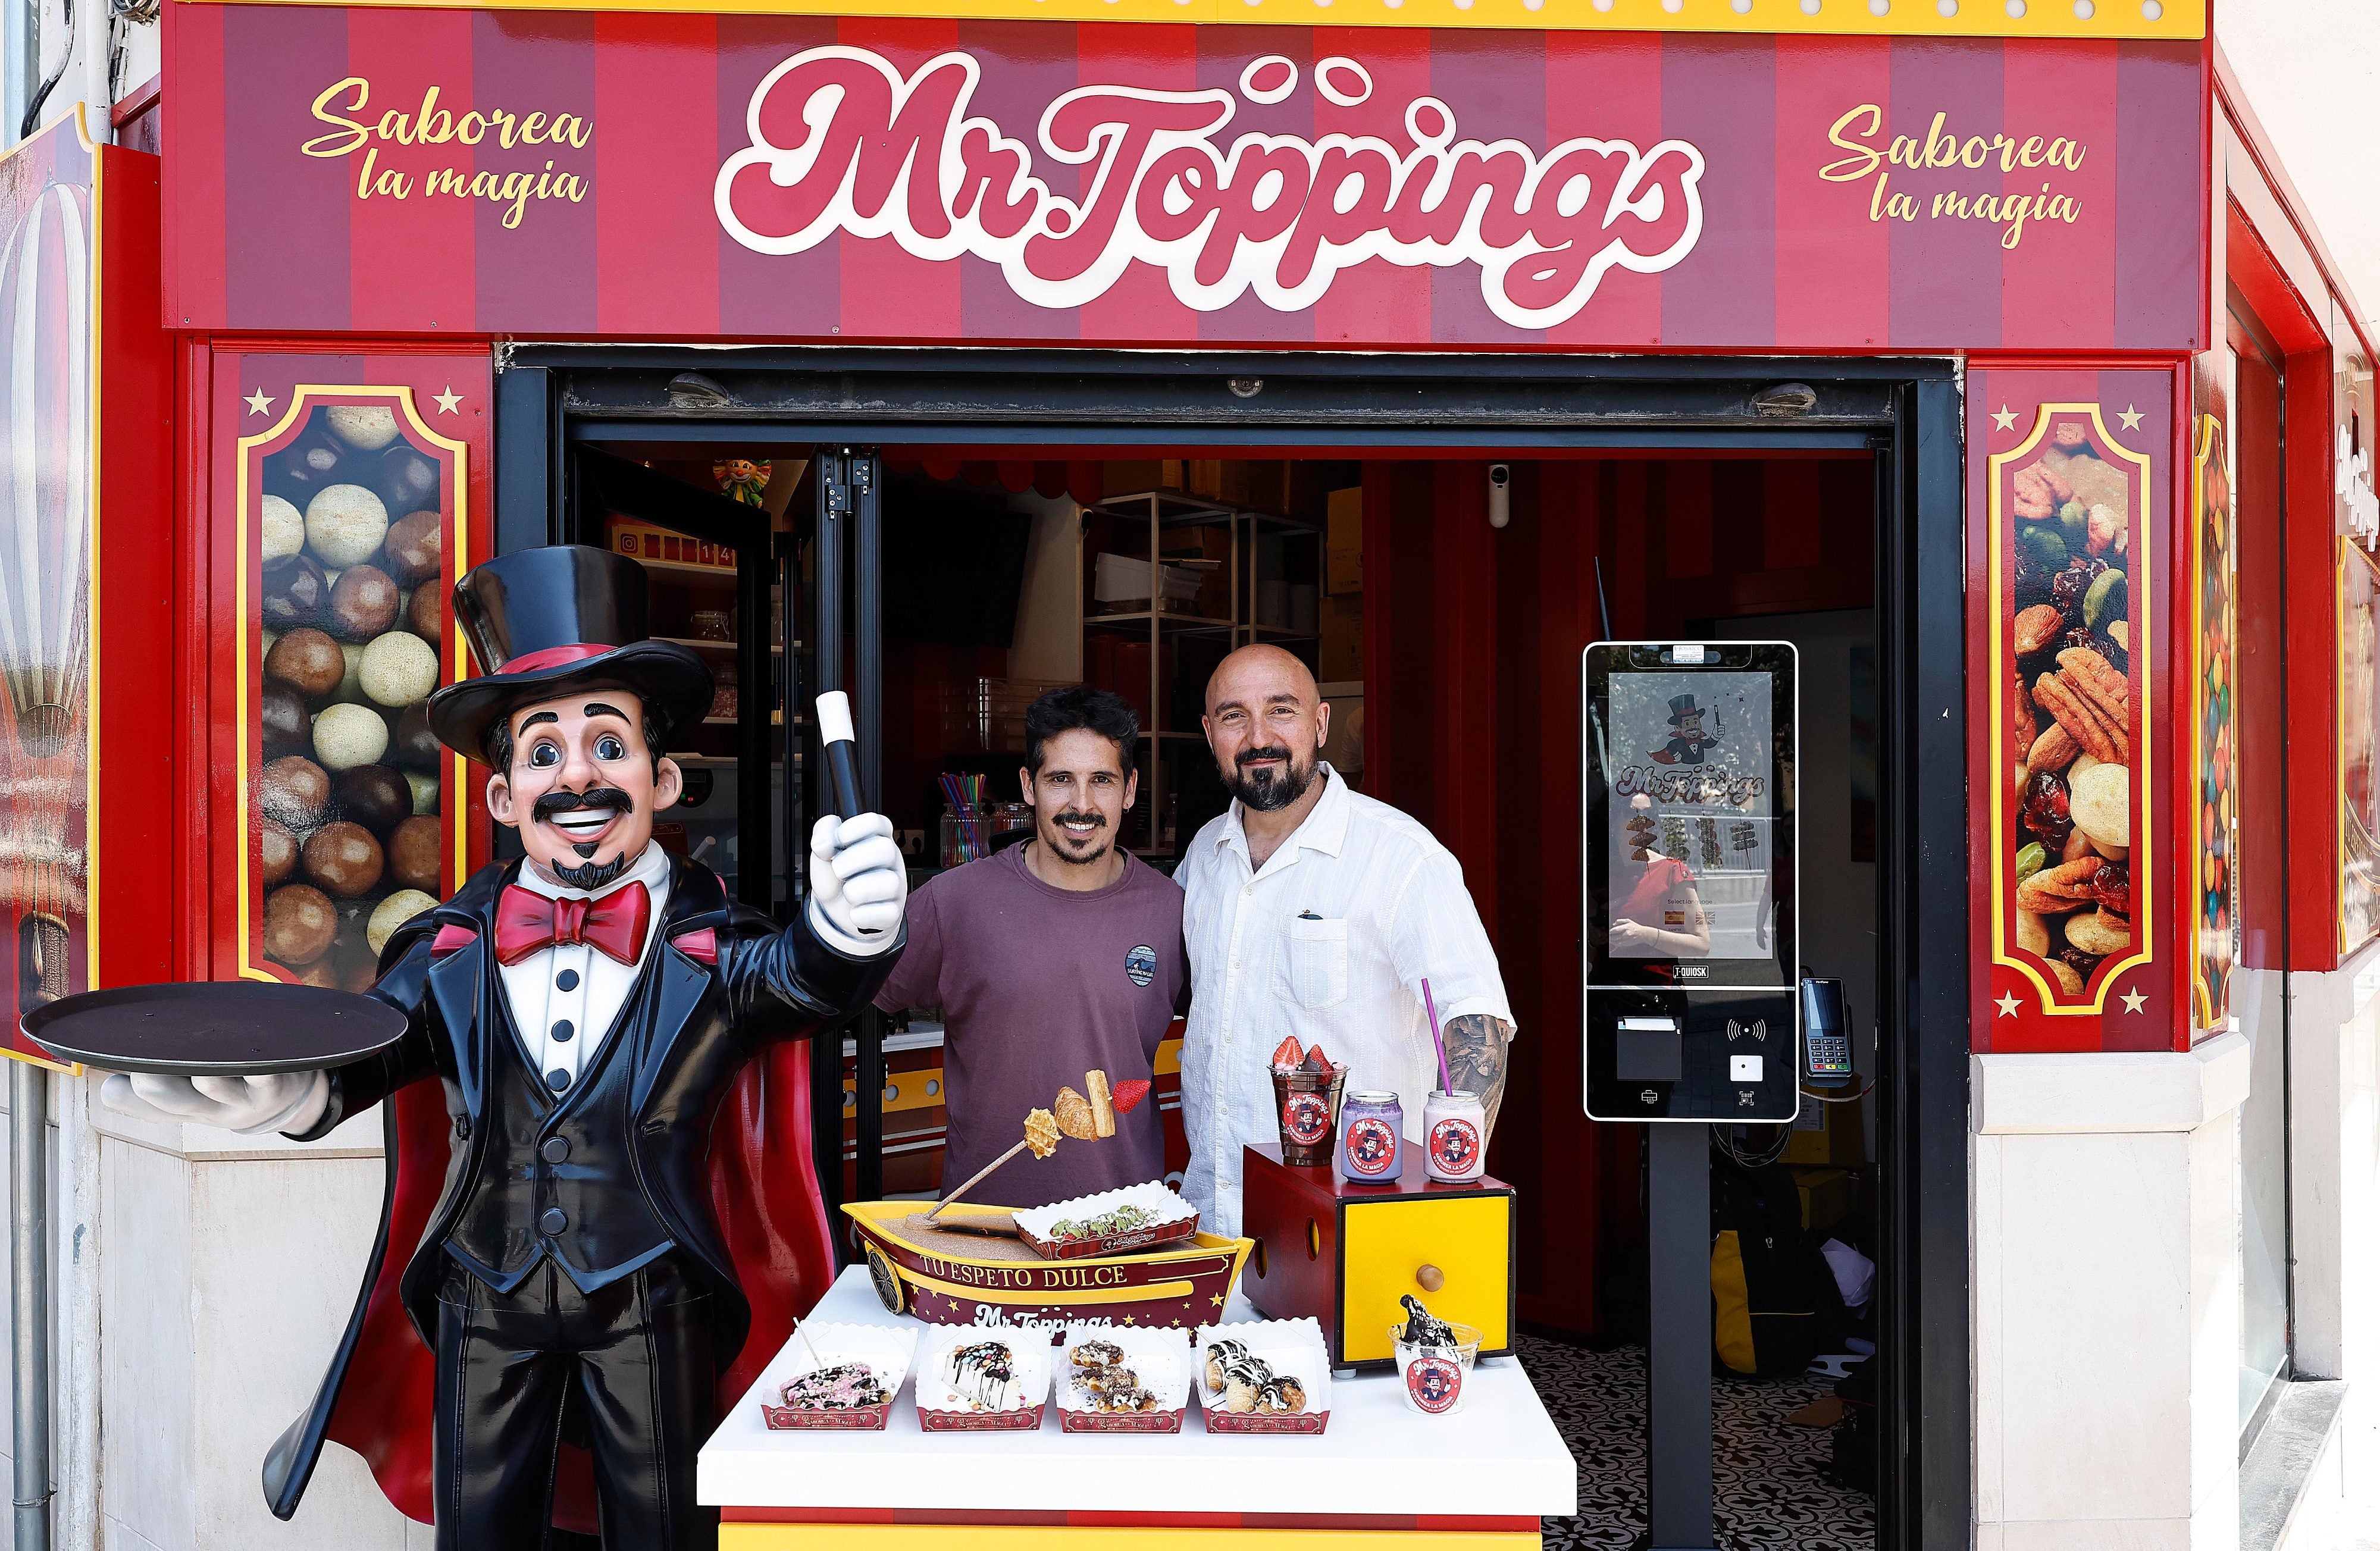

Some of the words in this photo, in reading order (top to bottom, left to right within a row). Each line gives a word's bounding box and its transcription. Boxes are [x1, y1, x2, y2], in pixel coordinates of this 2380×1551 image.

[300, 76, 593, 158] Saborea
[1818, 104, 2087, 182] Saborea
[357, 147, 414, 200] la
[424, 159, 589, 230] magia
[1869, 171, 1921, 222] la
[1931, 182, 2082, 249] magia
[1675, 967, 1707, 977] T-QUIOSK
[1289, 1124, 1304, 1140] SABOREA
[1311, 1129, 1324, 1140] MAGIA
[1349, 1146, 1362, 1166] SABOREA
[1435, 1152, 1452, 1169] SABOREA
[1459, 1158, 1473, 1170] MAGIA
[919, 1255, 945, 1276] TU
[950, 1262, 1032, 1287] ESPETO
[1042, 1265, 1128, 1287] DULCE
[1413, 1388, 1430, 1408] SABOREA
[1438, 1396, 1453, 1408] MAGIA
